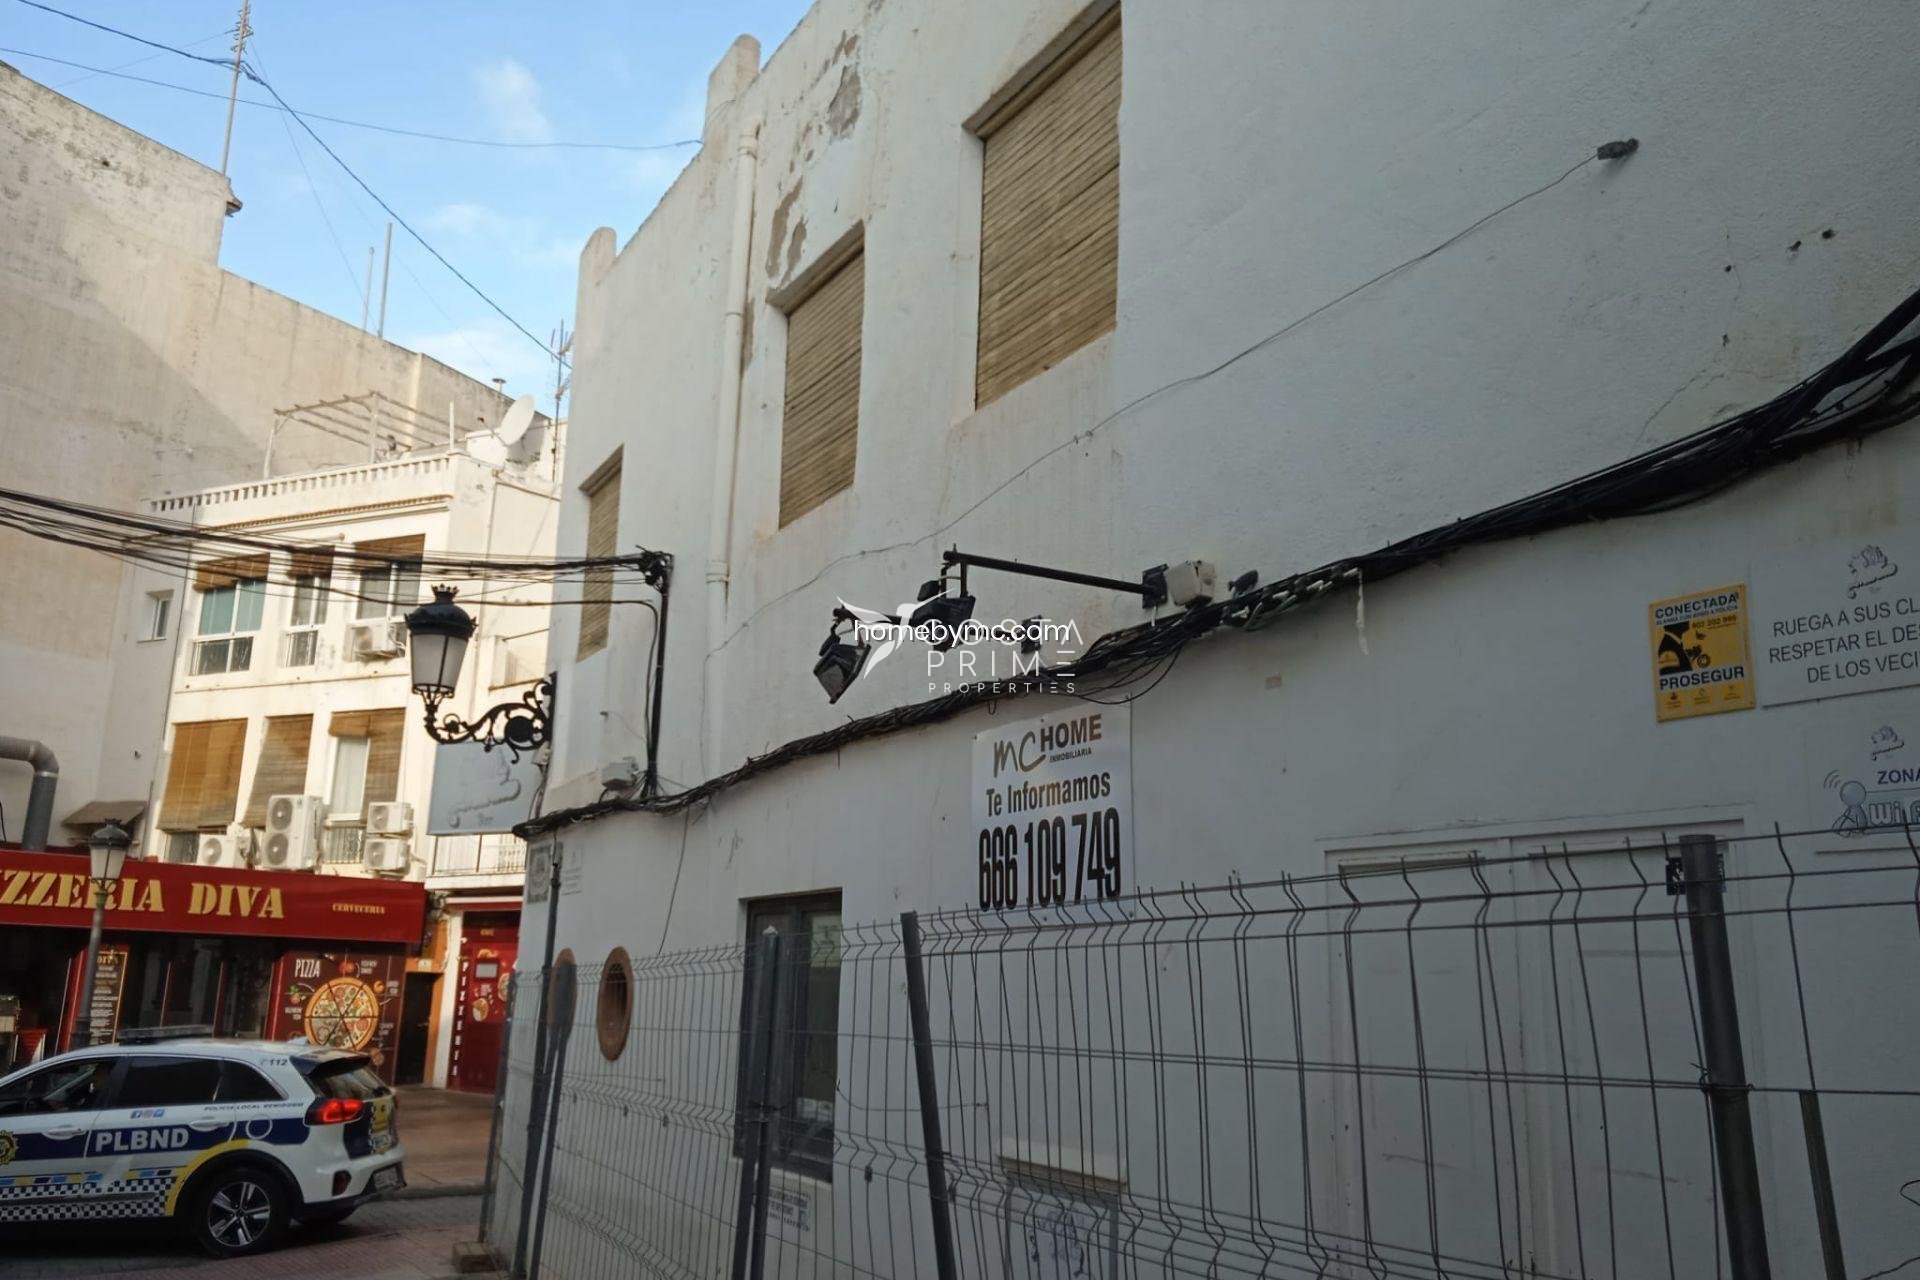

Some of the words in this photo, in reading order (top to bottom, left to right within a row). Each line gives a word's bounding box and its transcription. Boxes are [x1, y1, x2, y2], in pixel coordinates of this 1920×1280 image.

[1655, 594, 1738, 619] CONECTADA
[1773, 613, 1833, 637] RUEGA
[1838, 610, 1850, 625] A
[1854, 602, 1891, 623] SUS
[1769, 634, 1860, 663] RESPETAR
[1865, 630, 1887, 648] EL
[1892, 624, 1920, 643] DE
[1659, 666, 1745, 691] PROSEGUR
[1807, 664, 1831, 683] DE
[1836, 658, 1871, 679] LOS
[1040, 714, 1102, 752] HOME
[986, 788, 1002, 817] Te
[1008, 772, 1111, 814] Informamos
[979, 825, 1018, 912] 666
[1024, 816, 1066, 908] 109
[1072, 807, 1121, 905] 749
[0, 869, 164, 912] ZZERIA
[187, 882, 284, 919] DIVA
[332, 902, 386, 914] CERVECERIA
[295, 959, 320, 978] PIZZA
[270, 1059, 288, 1067] 112
[95, 1127, 189, 1152] PLBND
